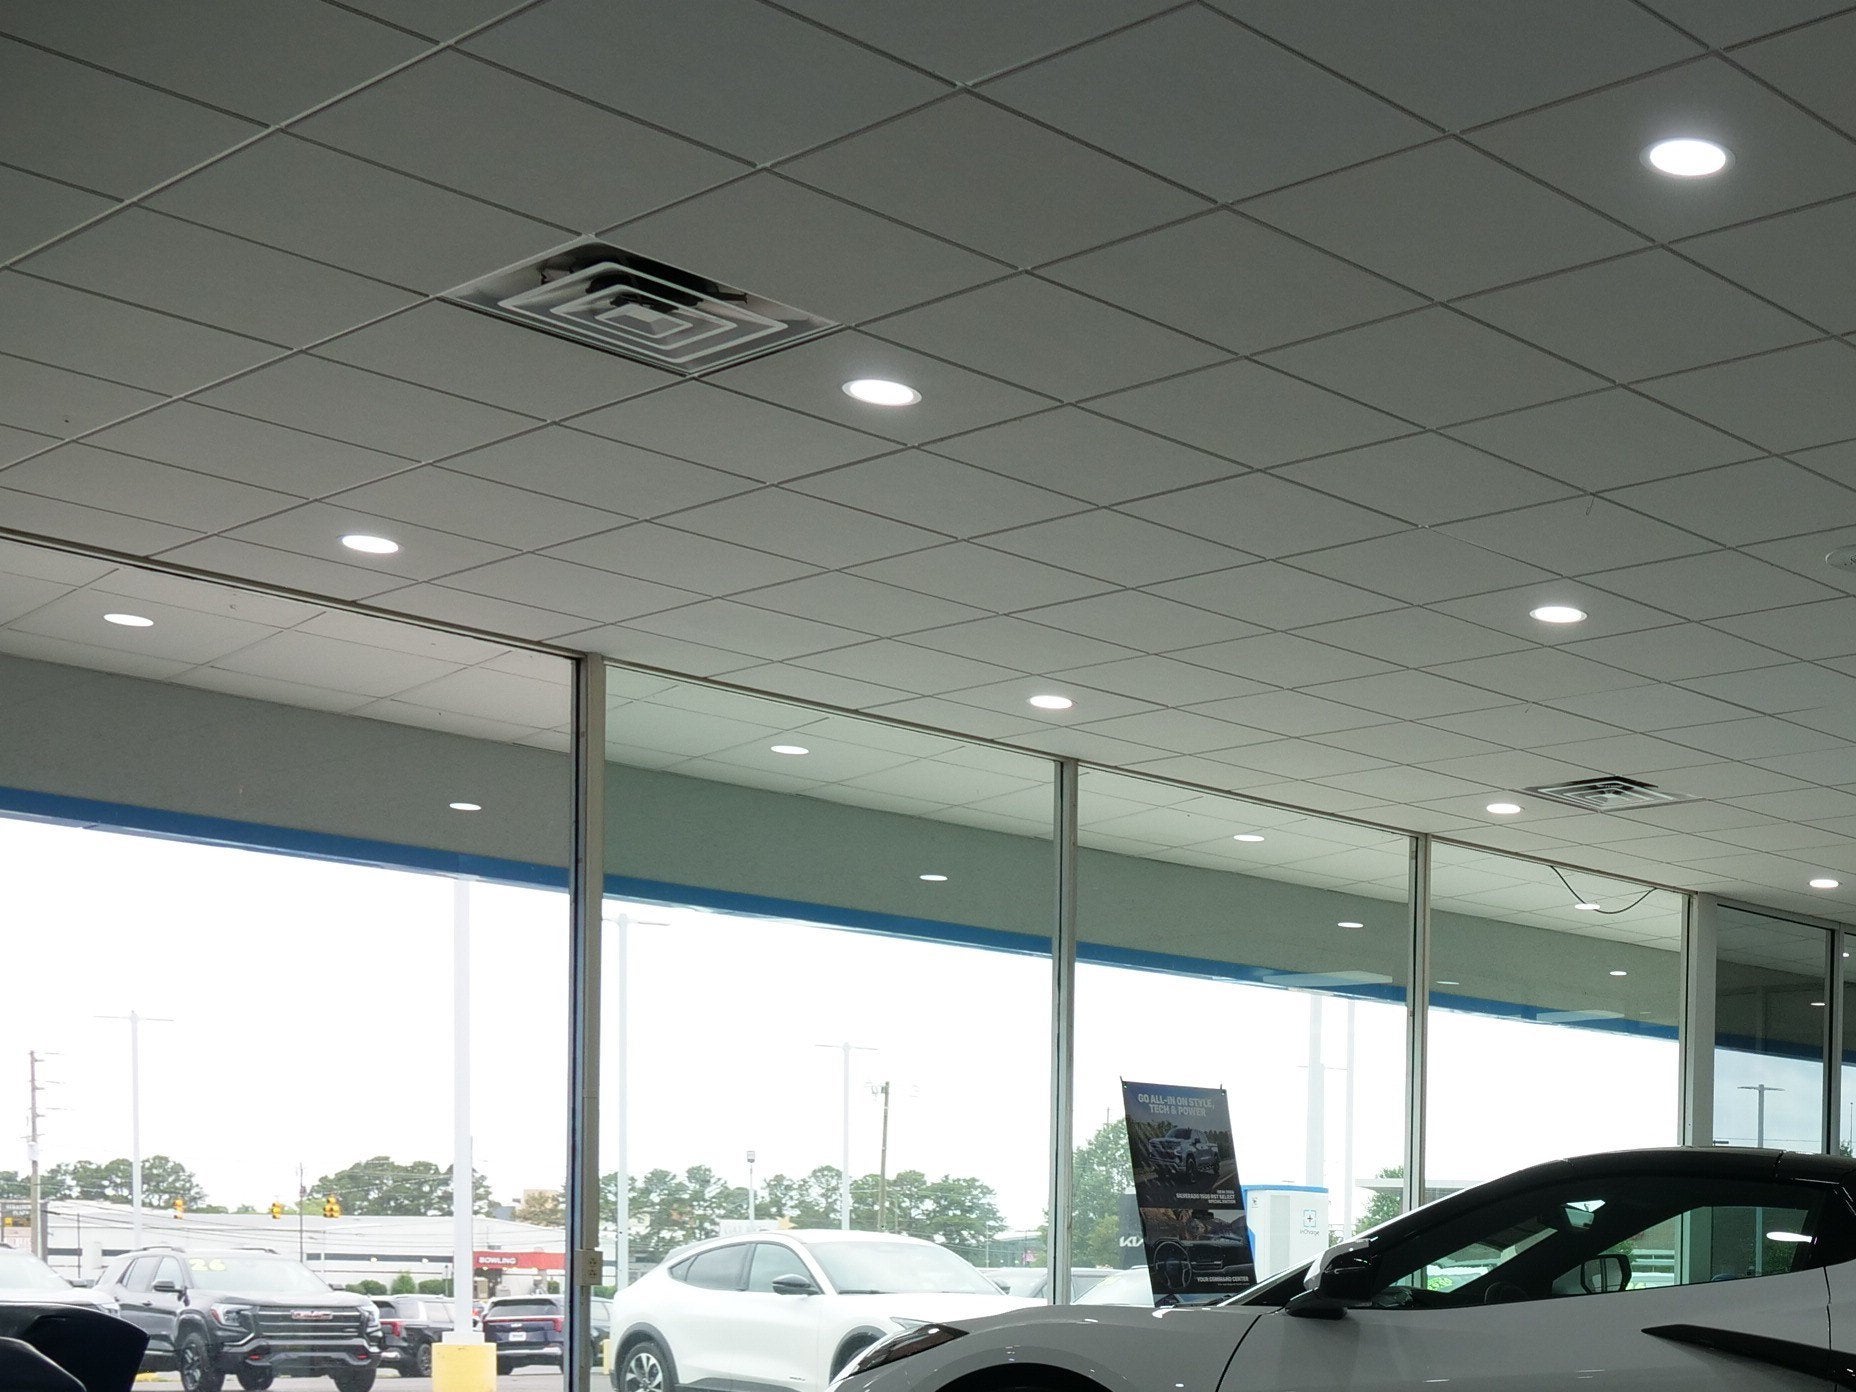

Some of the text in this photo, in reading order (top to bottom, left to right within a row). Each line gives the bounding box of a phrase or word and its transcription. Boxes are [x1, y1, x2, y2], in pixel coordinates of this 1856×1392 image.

[1138, 1093, 1215, 1110] GO ALL-IN ON STYLE,
[1149, 1104, 1170, 1114] TECH
[1178, 1106, 1207, 1117] POWER
[478, 1256, 517, 1265] BOWLING
